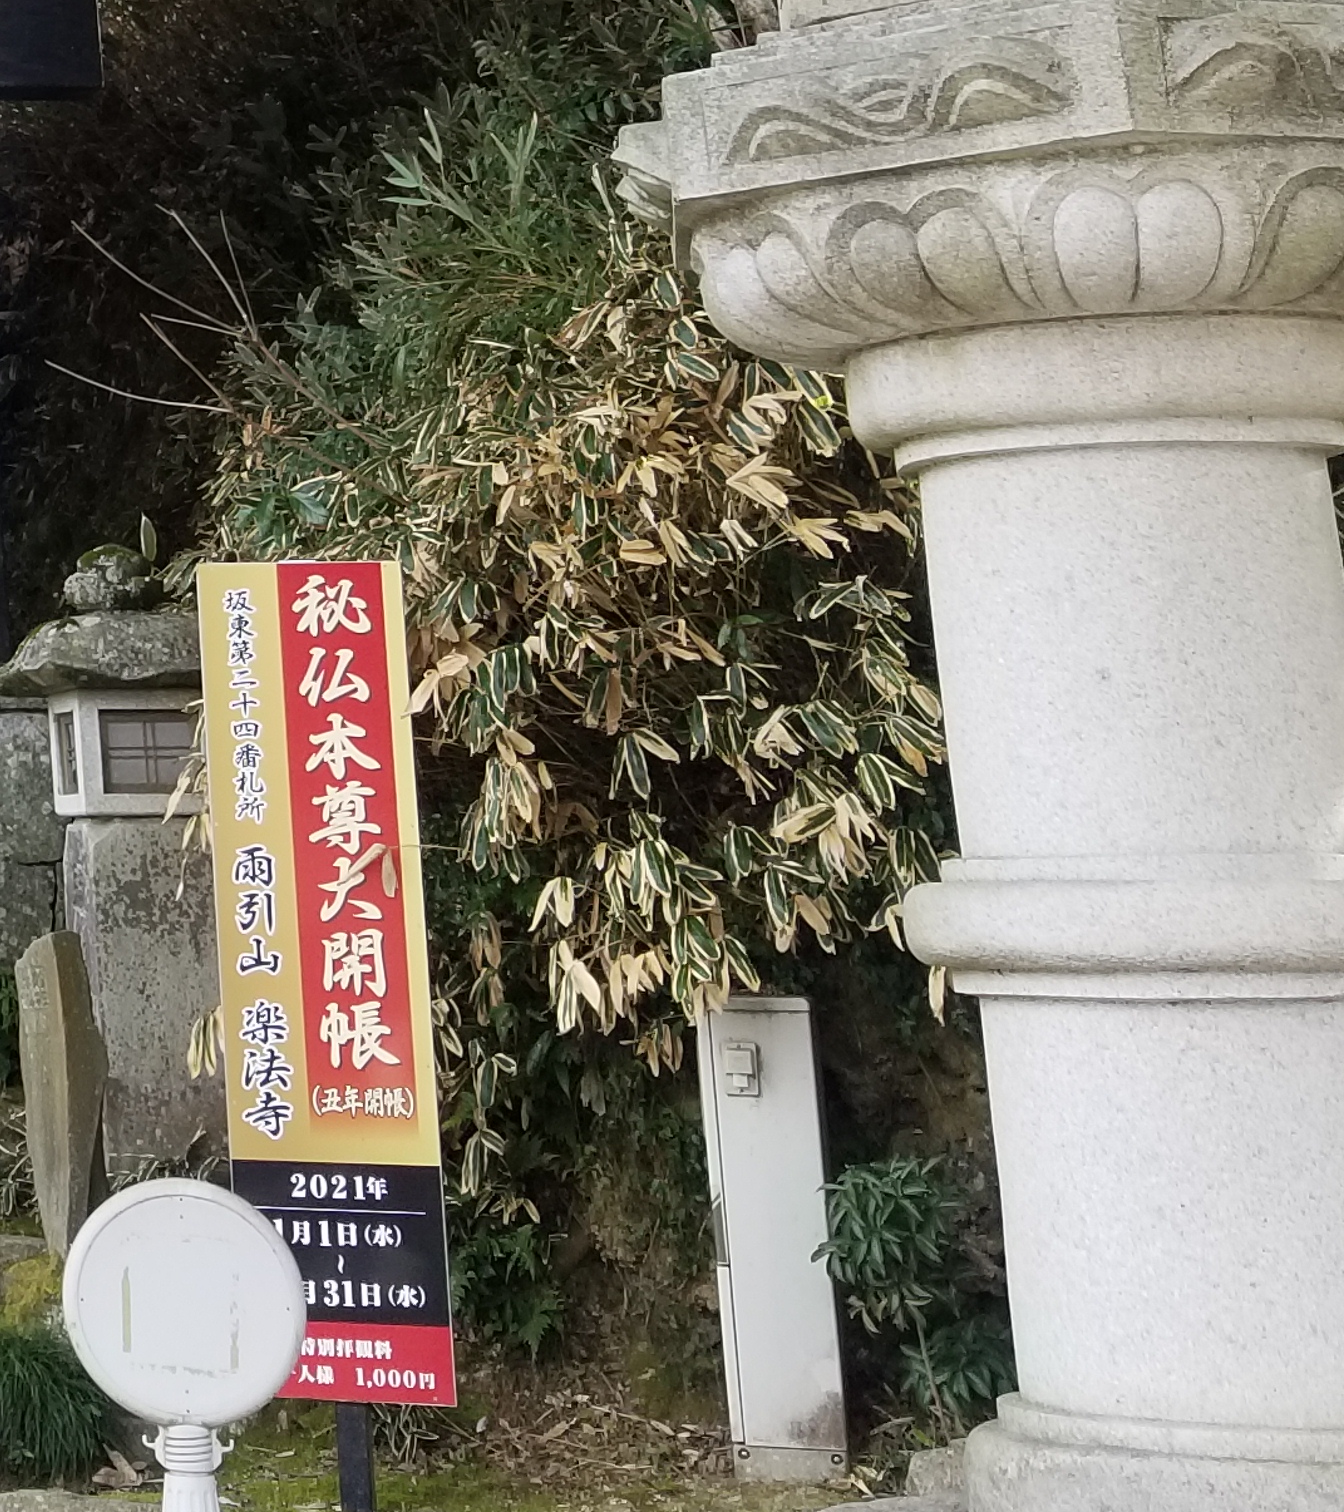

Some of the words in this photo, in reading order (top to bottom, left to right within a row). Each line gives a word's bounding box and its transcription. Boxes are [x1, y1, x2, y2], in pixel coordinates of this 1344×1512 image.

[223, 589, 265, 823] 坂東第二十四番札所
[291, 574, 401, 1070] 秘仏本尊大開帳
[234, 845, 280, 974] 雨引山
[242, 1000, 292, 1138] 楽法寺
[290, 1173, 388, 1201] 2021年
[291, 1364, 335, 1385] 人様
[355, 1367, 436, 1390] 1,000円
